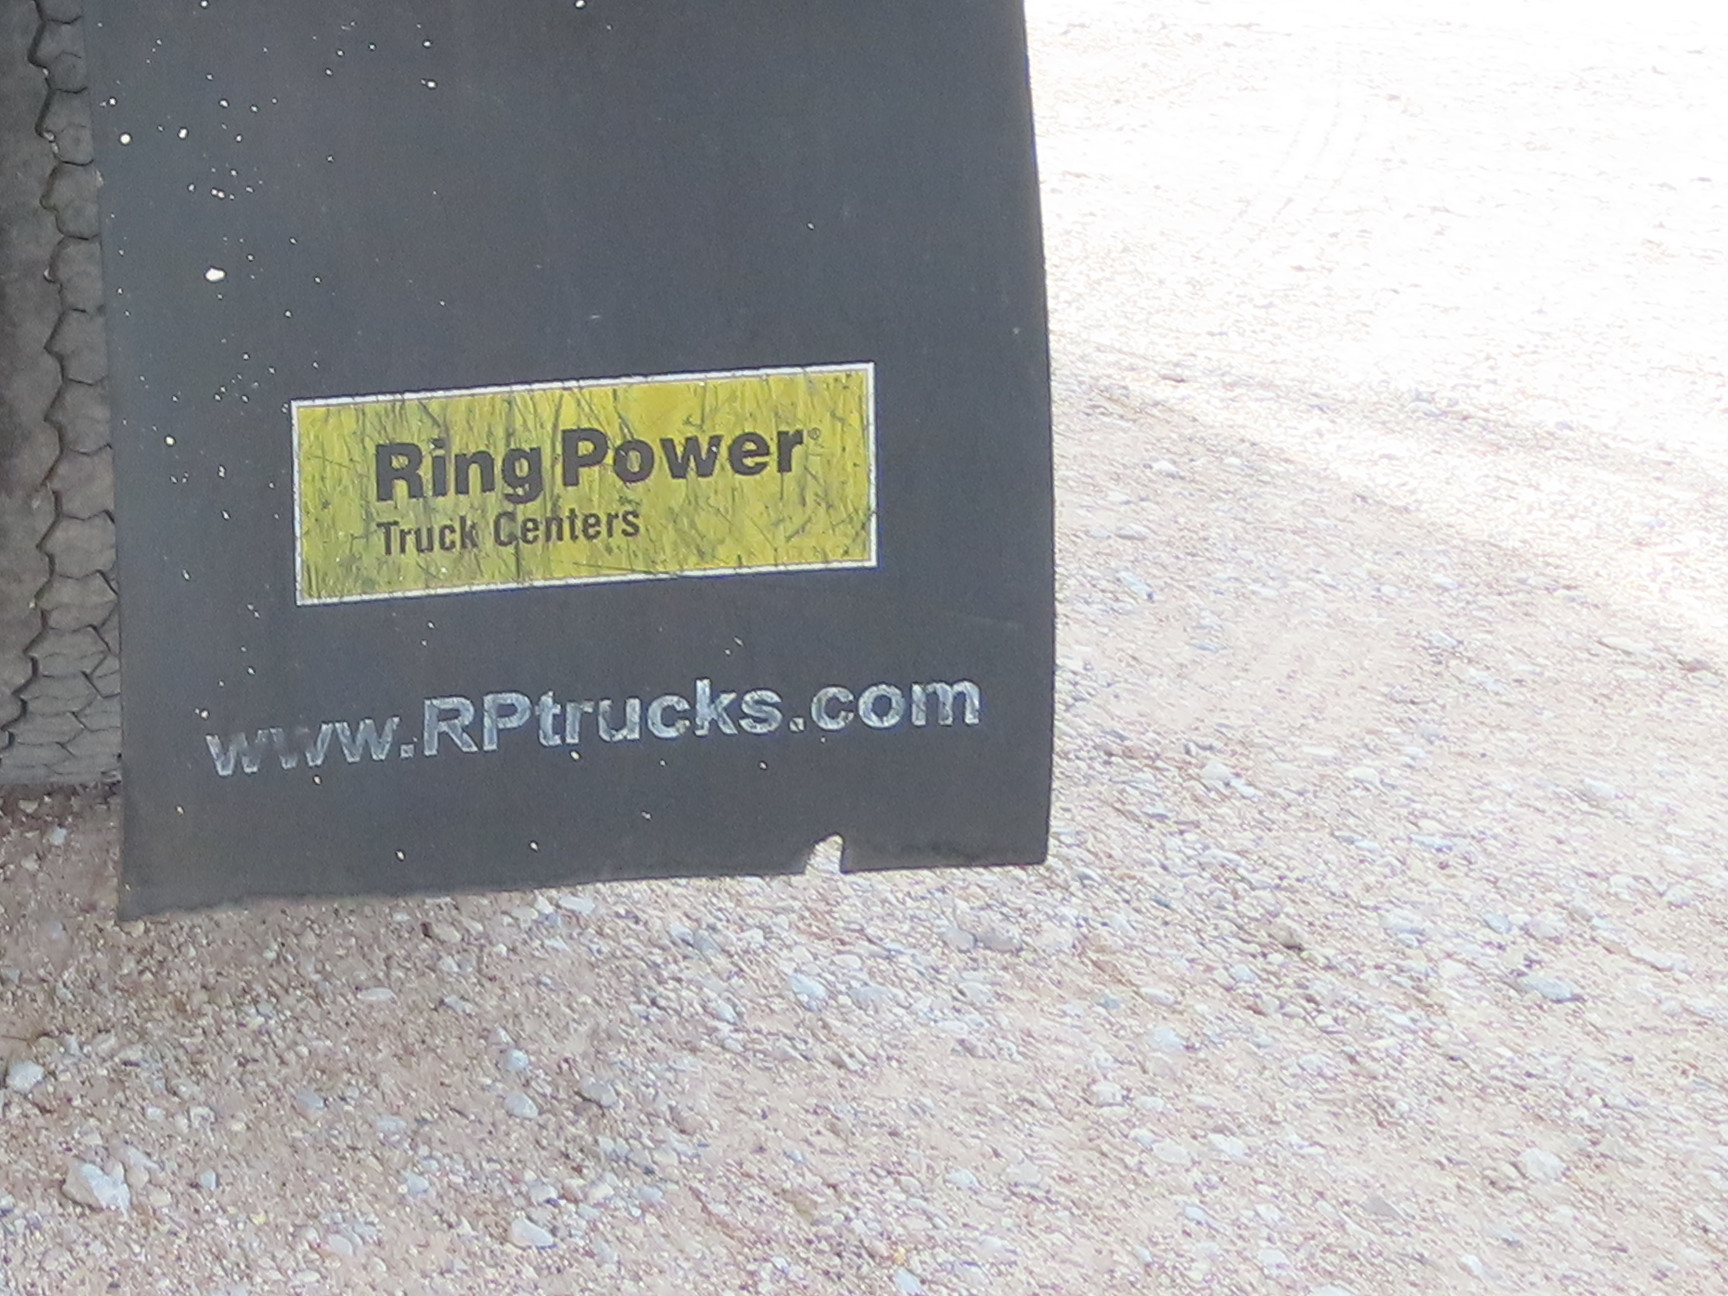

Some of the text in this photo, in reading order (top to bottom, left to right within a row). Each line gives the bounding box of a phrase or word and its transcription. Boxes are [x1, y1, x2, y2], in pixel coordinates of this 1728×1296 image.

[375, 439, 543, 504] Ring
[376, 508, 641, 556] Truck Centers
[205, 677, 983, 777] www.RPtrucks.com
